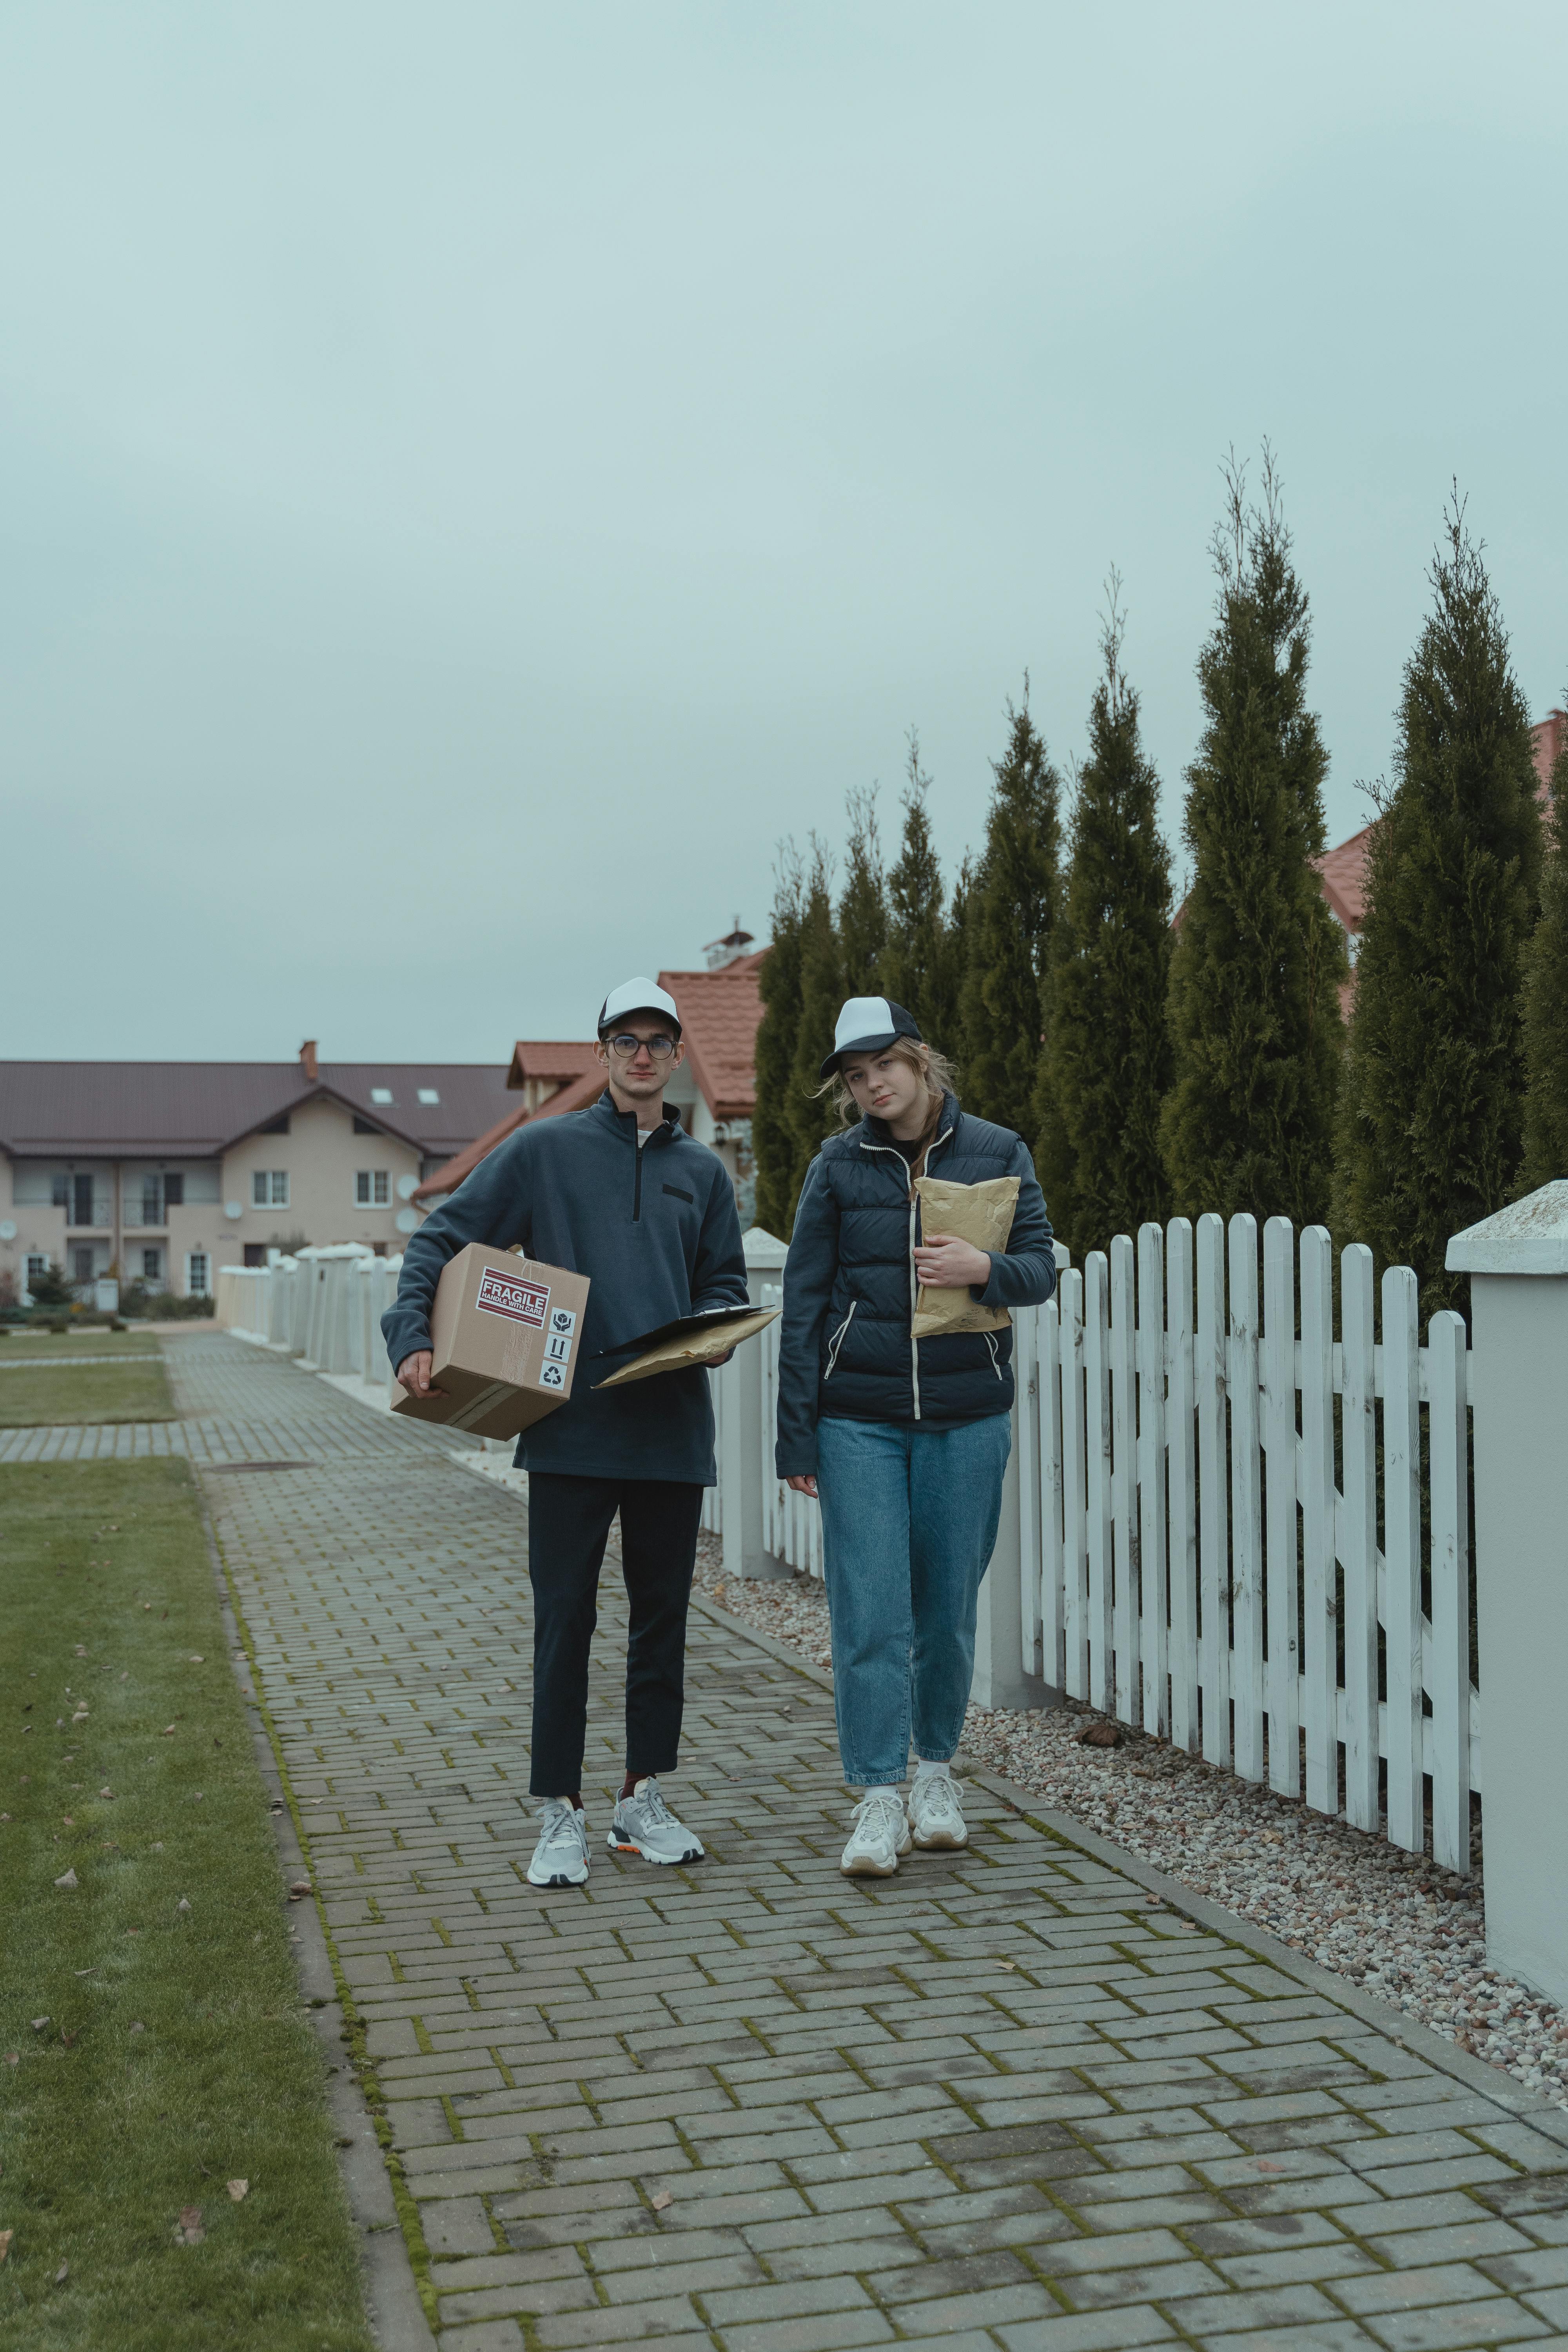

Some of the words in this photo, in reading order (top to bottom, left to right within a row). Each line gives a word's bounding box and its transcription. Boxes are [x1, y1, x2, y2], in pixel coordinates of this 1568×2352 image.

[482, 1292, 507, 1305] HANDLE
[508, 1300, 524, 1310] WITH
[525, 1306, 543, 1316] CARE
[483, 1281, 544, 1310] FRAGILE
